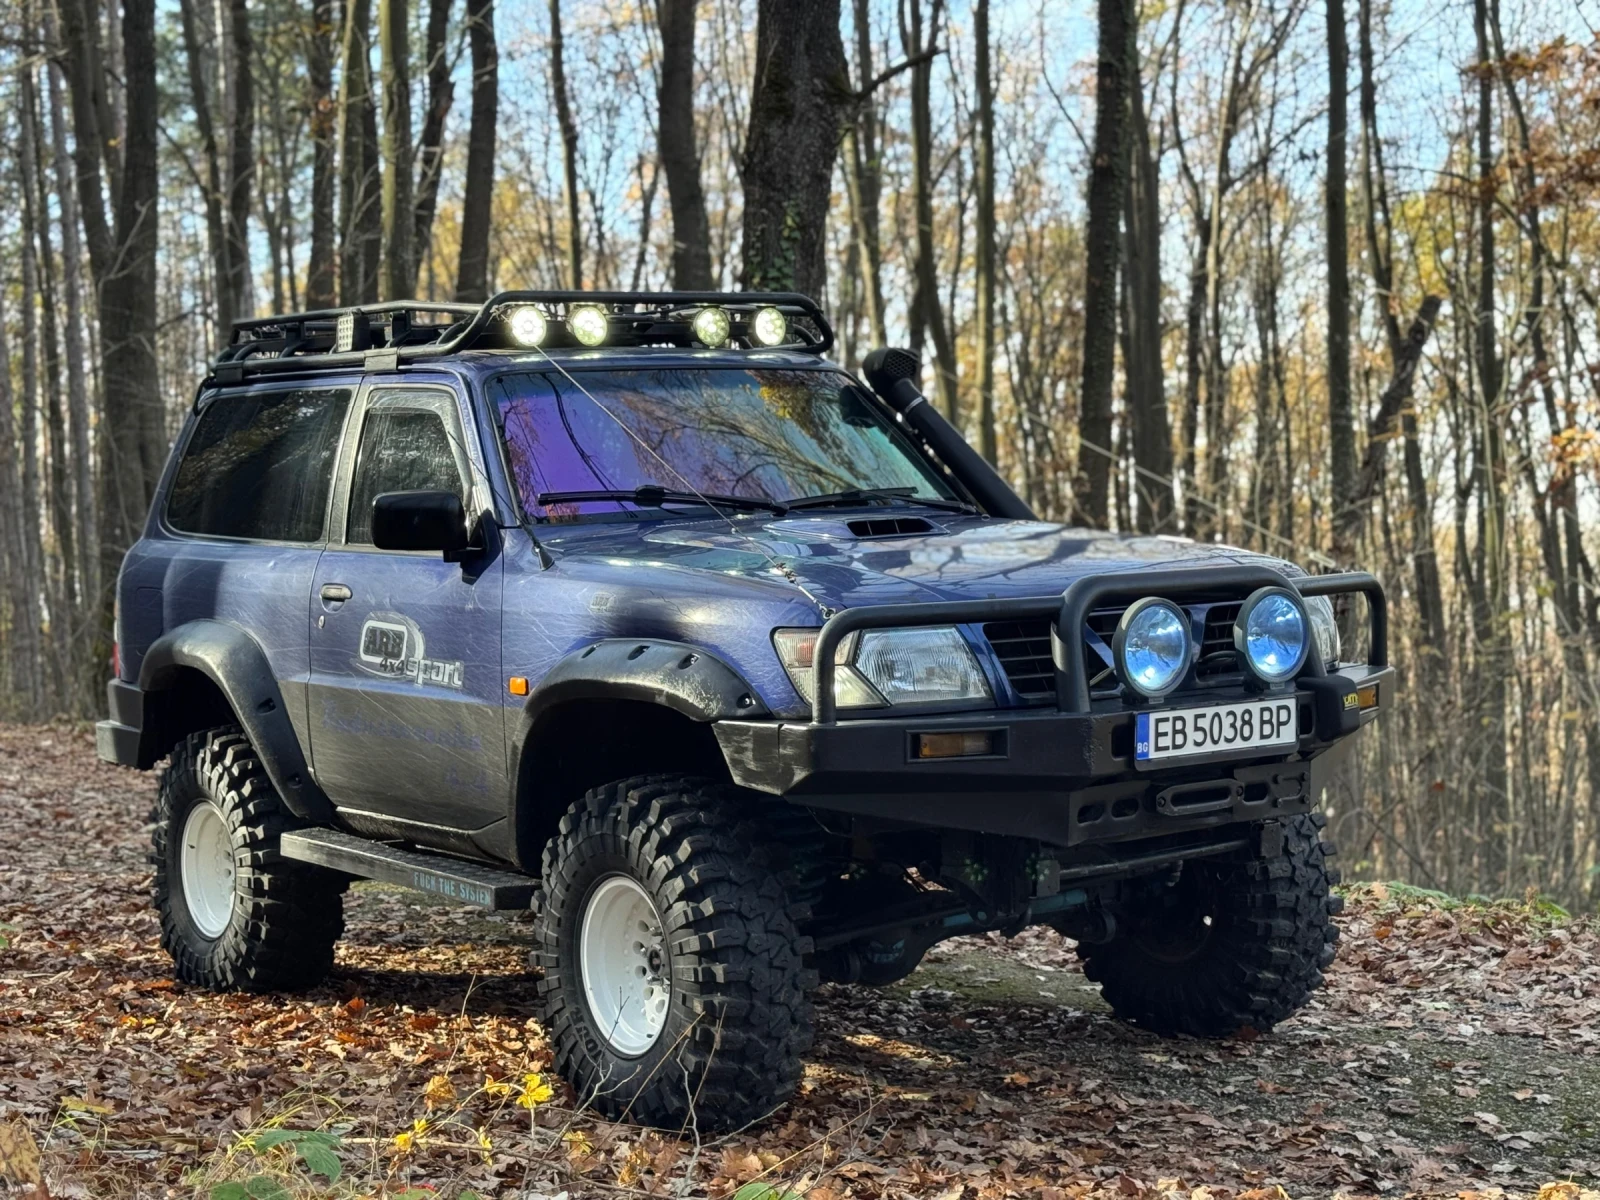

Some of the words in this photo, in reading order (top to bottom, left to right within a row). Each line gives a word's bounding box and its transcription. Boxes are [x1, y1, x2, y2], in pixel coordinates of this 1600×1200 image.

[380, 656, 405, 676] 4x4
[1154, 715, 1188, 753] EB
[1193, 708, 1254, 747] 5038
[1259, 704, 1291, 741] BP
[1137, 742, 1149, 753] BG
[413, 872, 436, 891] FUCK
[438, 877, 456, 897] THE
[459, 882, 491, 905] SYSTEM
